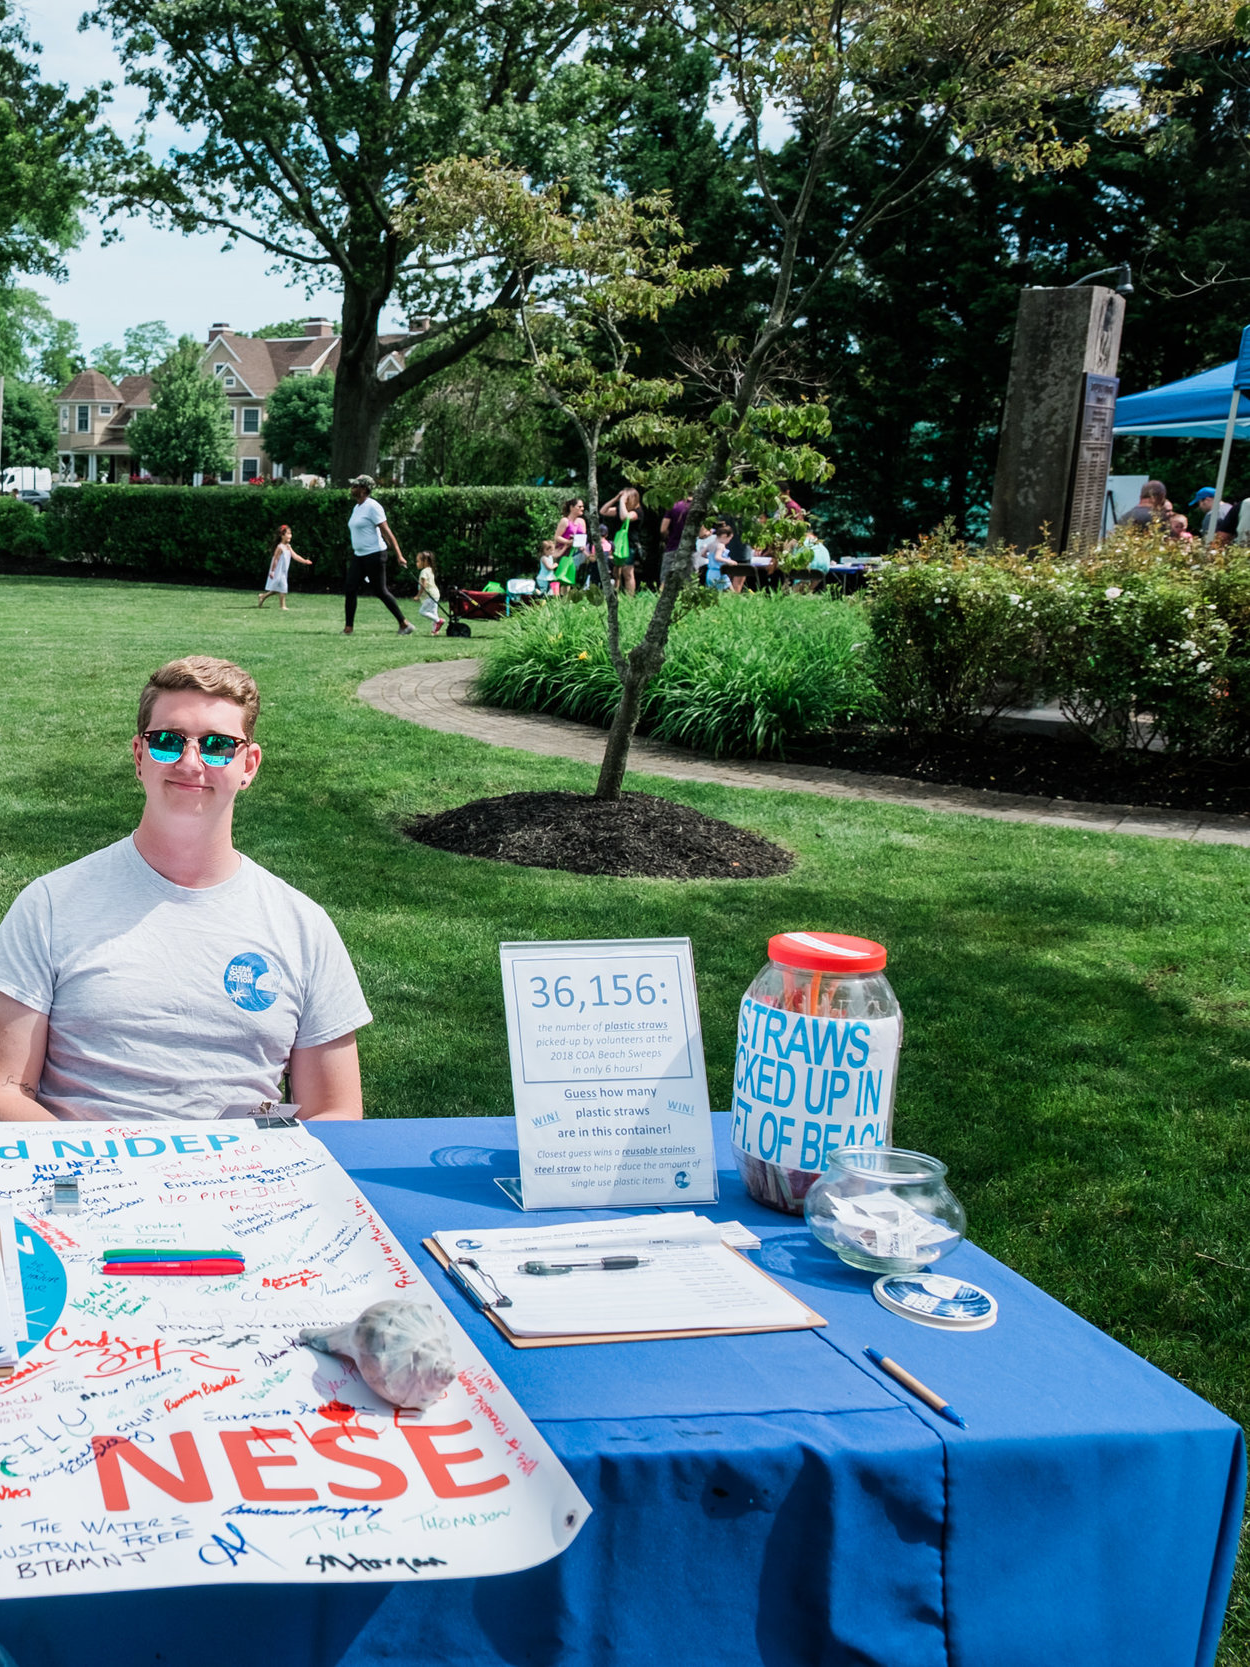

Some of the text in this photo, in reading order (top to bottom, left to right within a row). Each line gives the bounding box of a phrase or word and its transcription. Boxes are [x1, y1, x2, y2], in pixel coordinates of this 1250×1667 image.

[228, 976, 253, 984] ACTION
[529, 973, 668, 1013] 36,156:
[538, 1021, 668, 1032] the number of plastic straws
[740, 999, 870, 1069] STRAWS
[536, 1034, 672, 1048] picked-up by volunteers at the
[550, 1049, 662, 1061] 2018 COA Beach Sweeps
[572, 1064, 643, 1076] in only 6 hours!
[735, 1046, 882, 1117] CKED UP IN
[564, 1087, 657, 1099] Guess how many
[575, 1106, 650, 1119] plastic straws
[667, 1100, 695, 1114] WIN!
[531, 1111, 560, 1127] WIN!
[557, 1124, 671, 1138] are in this container!
[758, 1111, 795, 1164] OF
[52, 1134, 240, 1159] NJDEP
[537, 1149, 566, 1159] Closest
[568, 1151, 592, 1160] guess
[594, 1149, 612, 1157] wins
[622, 1146, 658, 1156] reusable
[660, 1145, 696, 1155] stainless
[35, 1163, 60, 1173] NO
[534, 1165, 555, 1175] steel
[557, 1165, 581, 1173] straw
[594, 1163, 611, 1173] help
[614, 1161, 642, 1171] reduce
[644, 1160, 657, 1170] the
[658, 1160, 690, 1169] amount
[692, 1158, 701, 1170] of
[192, 1177, 229, 1188] FOSSIL
[229, 1173, 260, 1183] FUEL
[571, 1178, 596, 1188] single
[598, 1178, 611, 1186] use
[614, 1176, 640, 1187] plastic
[158, 1180, 297, 1205] NO PIPELINE!
[134, 1222, 184, 1234] protect
[92, 1420, 510, 1512] NESE
[21, 1517, 62, 1534] THE
[81, 1515, 191, 1535] WATERS
[289, 1515, 391, 1541] TYLER
[403, 1504, 511, 1531] THOMPSON
[119, 1528, 195, 1548] FREE
